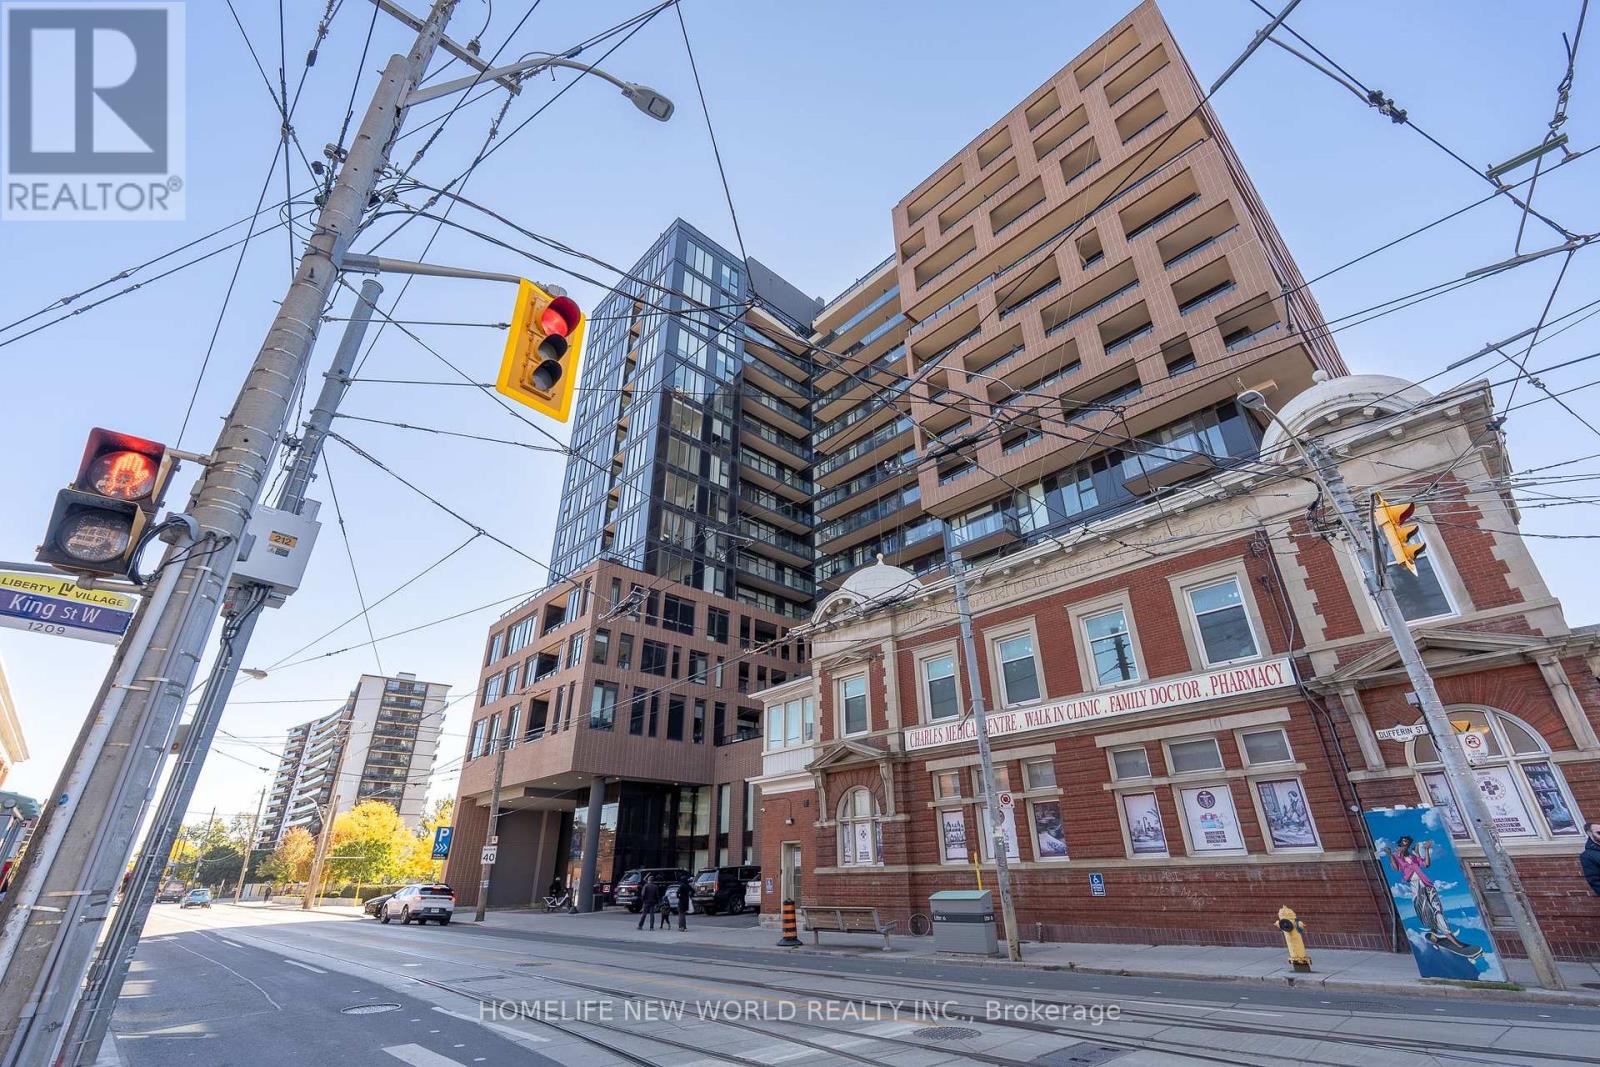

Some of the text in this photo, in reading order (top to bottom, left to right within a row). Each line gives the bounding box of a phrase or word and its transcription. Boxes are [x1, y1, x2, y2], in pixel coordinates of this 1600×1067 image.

[1, 577, 56, 593] LIBERTY
[75, 592, 124, 607] VILLAGE
[9, 593, 101, 623] King St W
[28, 621, 66, 635] 1209
[909, 662, 1285, 749] CHARLES MEDICA ENTRE WALK IN CLINIC FAMILY DOCTOR PHARMACY
[1378, 727, 1413, 739] DUFFERIN
[1415, 725, 1425, 734] ST
[438, 828, 450, 842] P
[482, 853, 496, 862] 40
